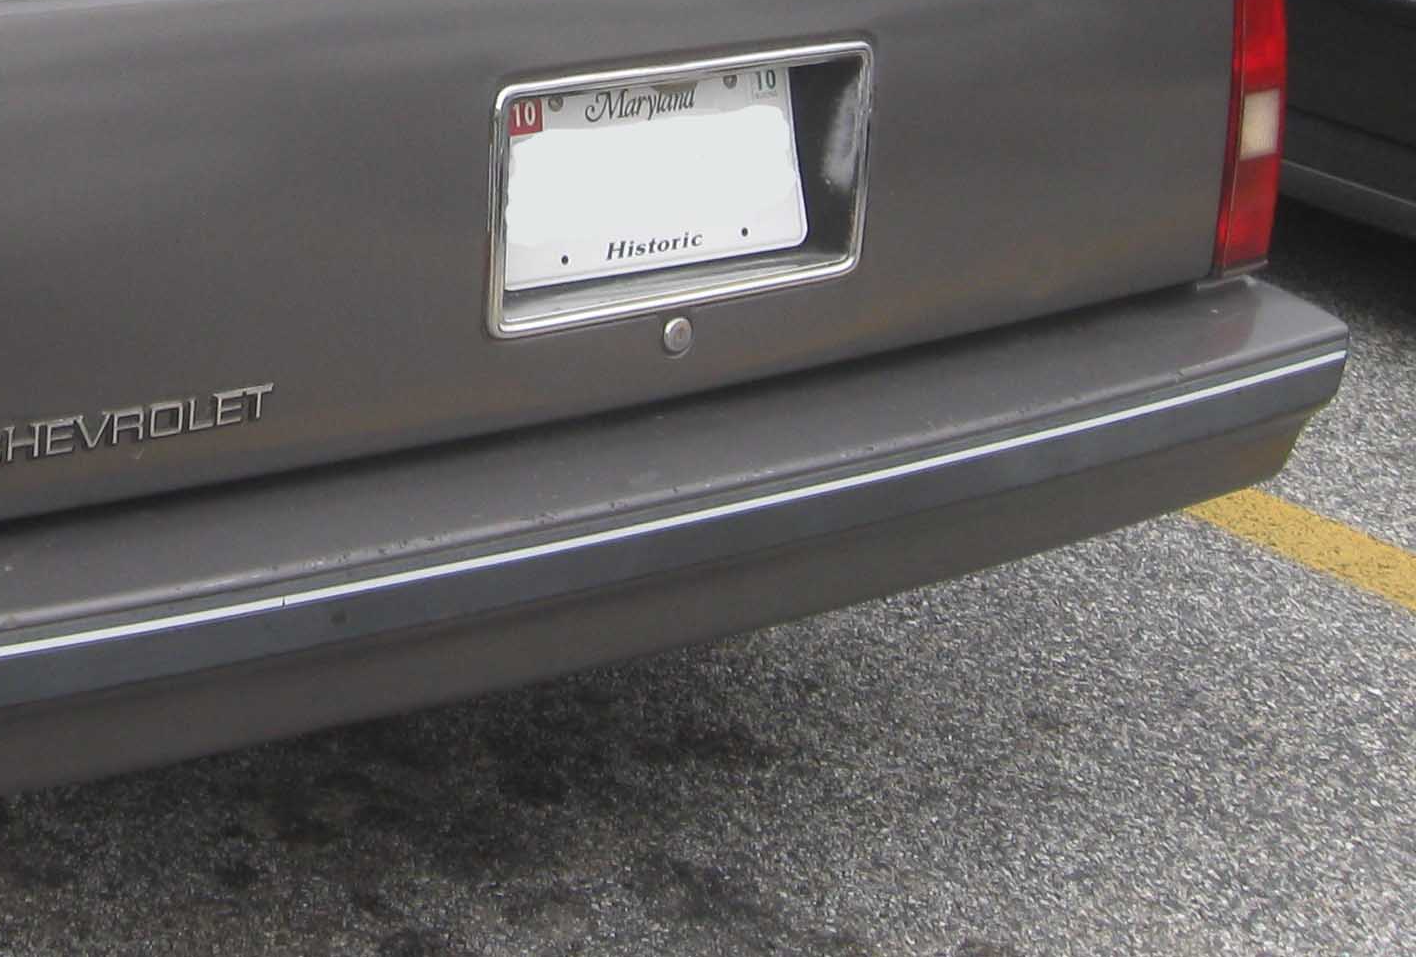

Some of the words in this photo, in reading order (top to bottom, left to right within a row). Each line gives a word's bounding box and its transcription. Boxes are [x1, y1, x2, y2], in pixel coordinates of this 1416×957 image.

[756, 69, 777, 92] 10
[512, 100, 537, 128] 10
[584, 88, 696, 123] Maryland
[604, 231, 704, 261] Historic
